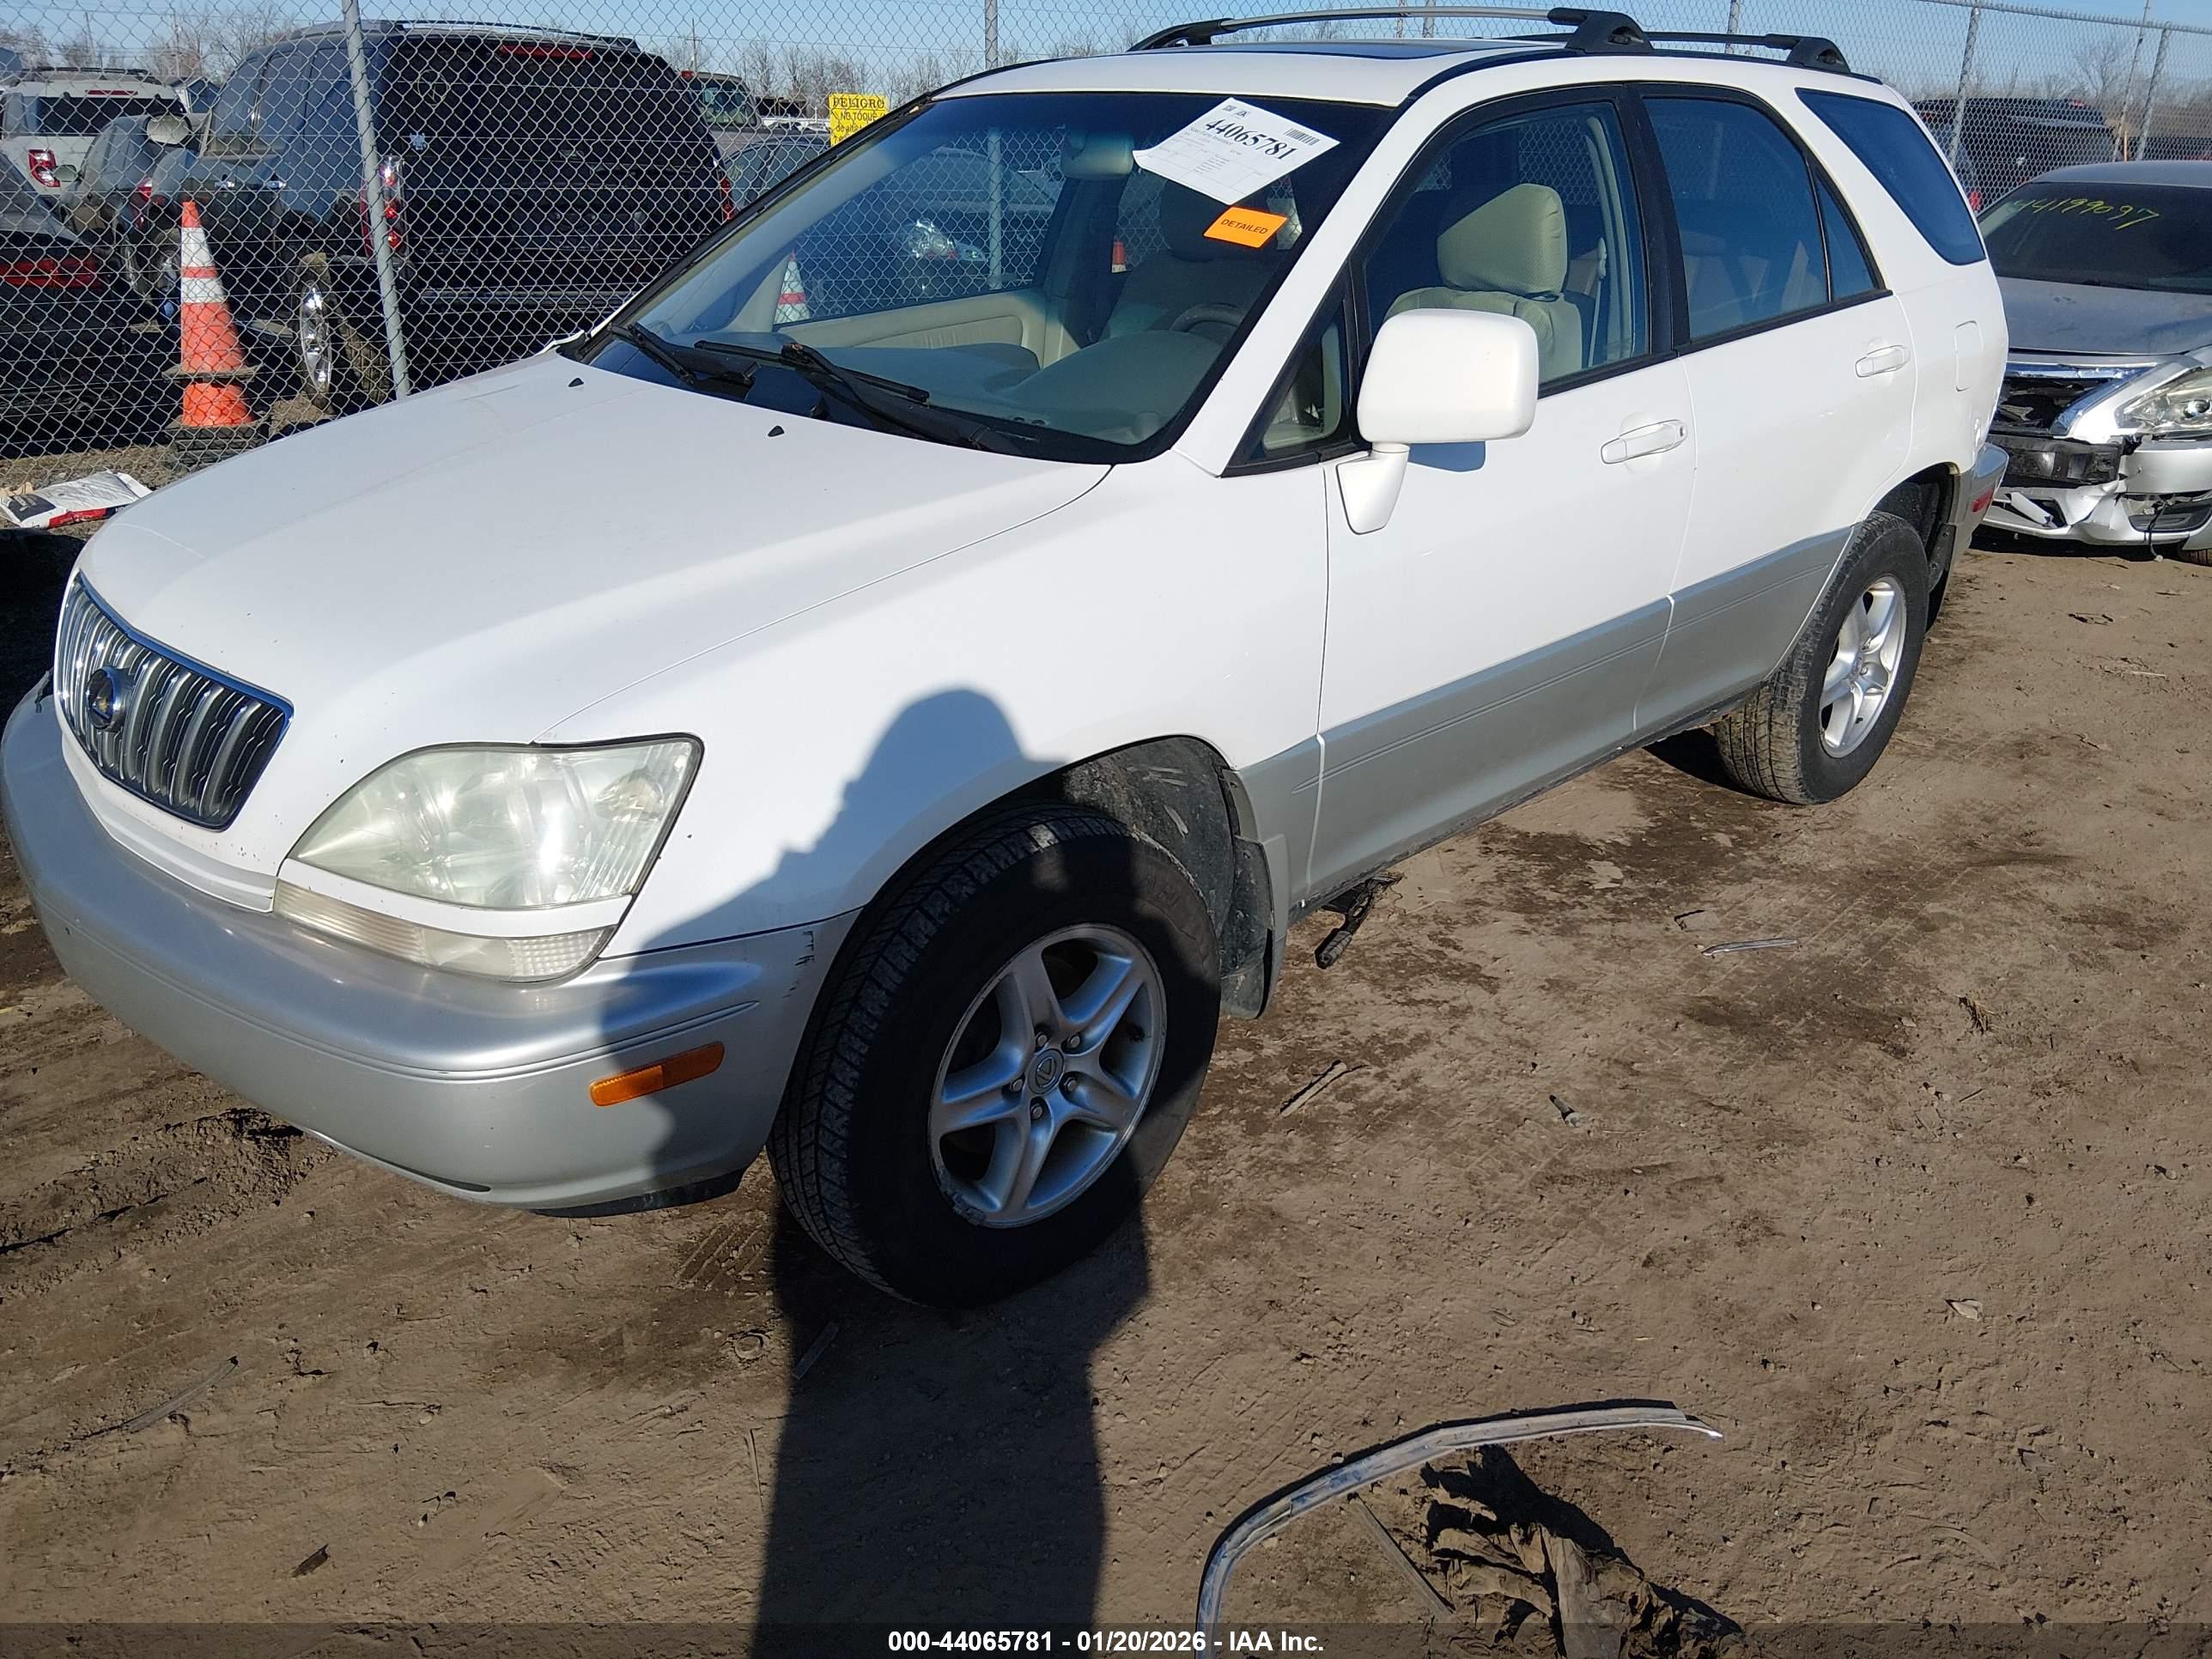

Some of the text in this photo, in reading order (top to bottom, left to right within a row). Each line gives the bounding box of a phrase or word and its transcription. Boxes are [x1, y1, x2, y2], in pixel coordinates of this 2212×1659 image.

[832, 97, 884, 109] PELIGRO
[841, 112, 851, 121] NO
[836, 124, 845, 132] de
[1205, 118, 1299, 161] 44065781
[1220, 218, 1268, 236] DETAILED
